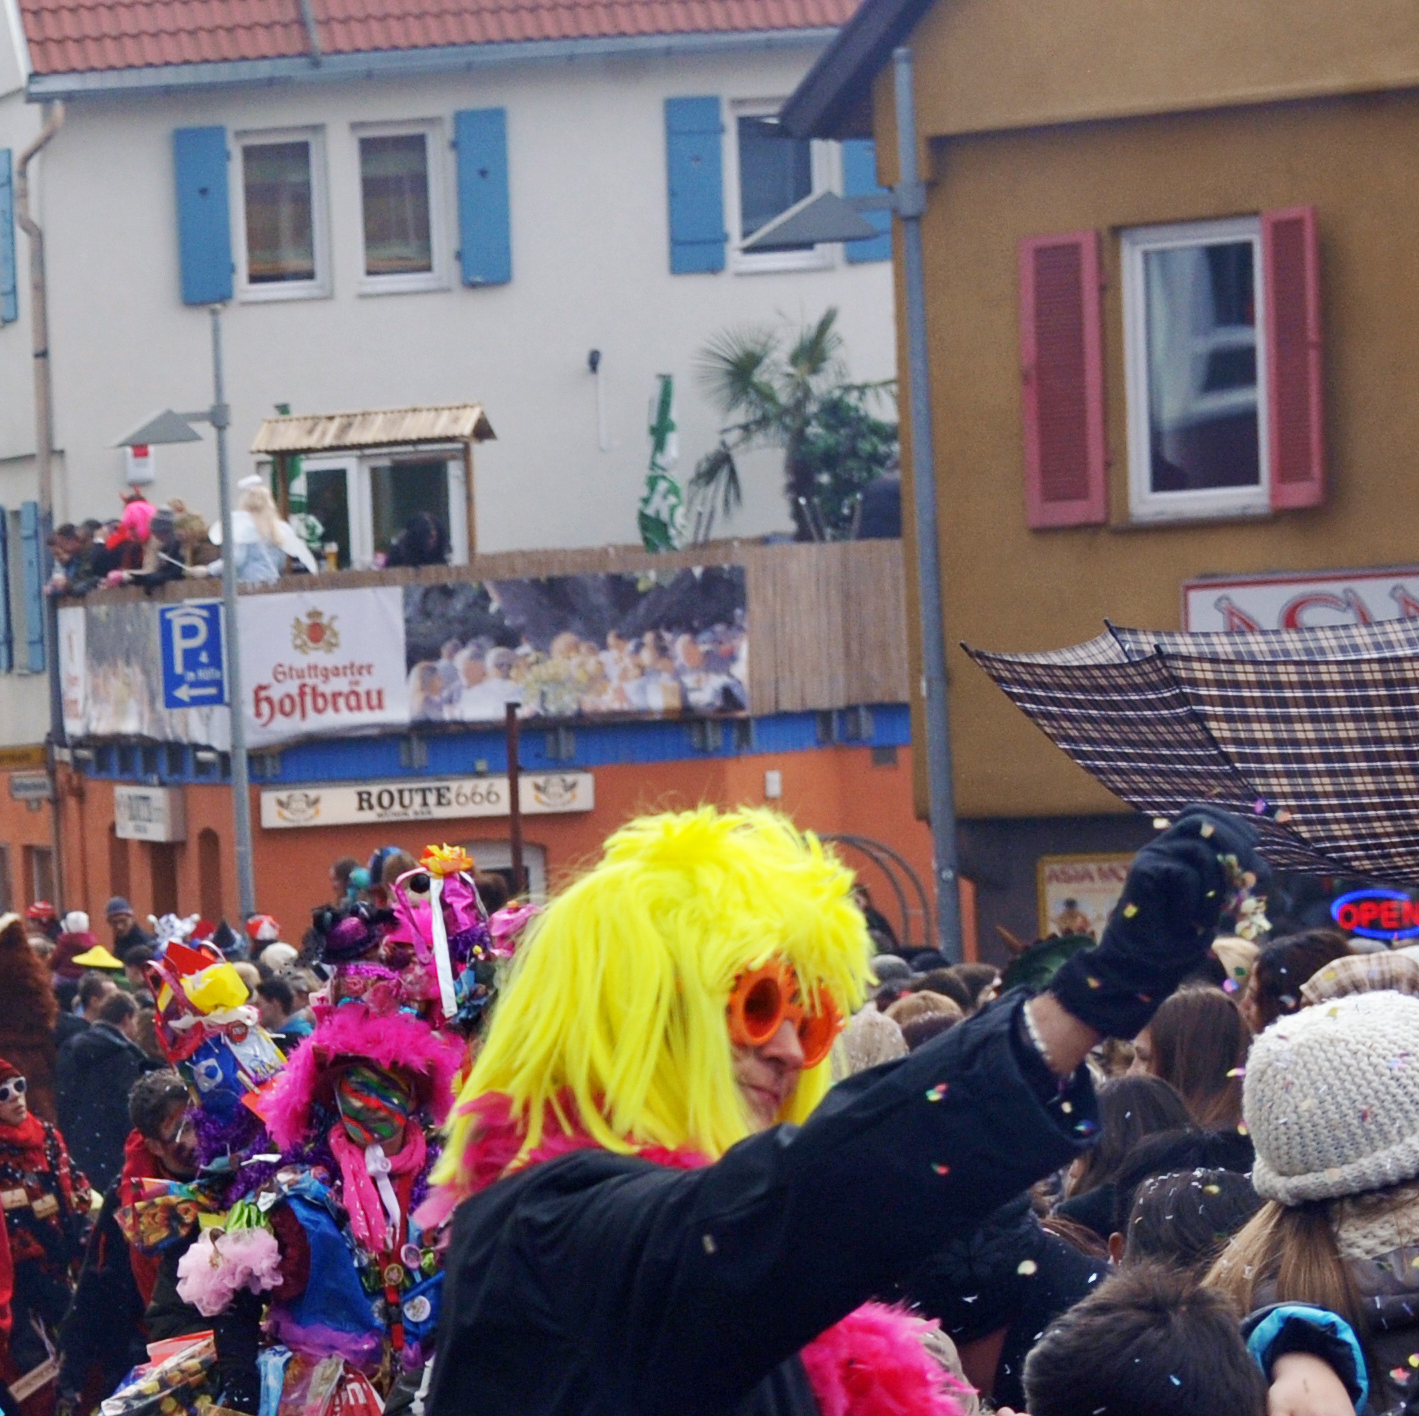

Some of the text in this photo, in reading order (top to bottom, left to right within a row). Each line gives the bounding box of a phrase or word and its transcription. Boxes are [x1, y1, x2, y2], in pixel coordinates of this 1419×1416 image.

[171, 615, 209, 676] P
[272, 662, 374, 684] Stuttgarter
[253, 680, 385, 728] Hofbräu
[356, 782, 500, 813] ROUTE 666
